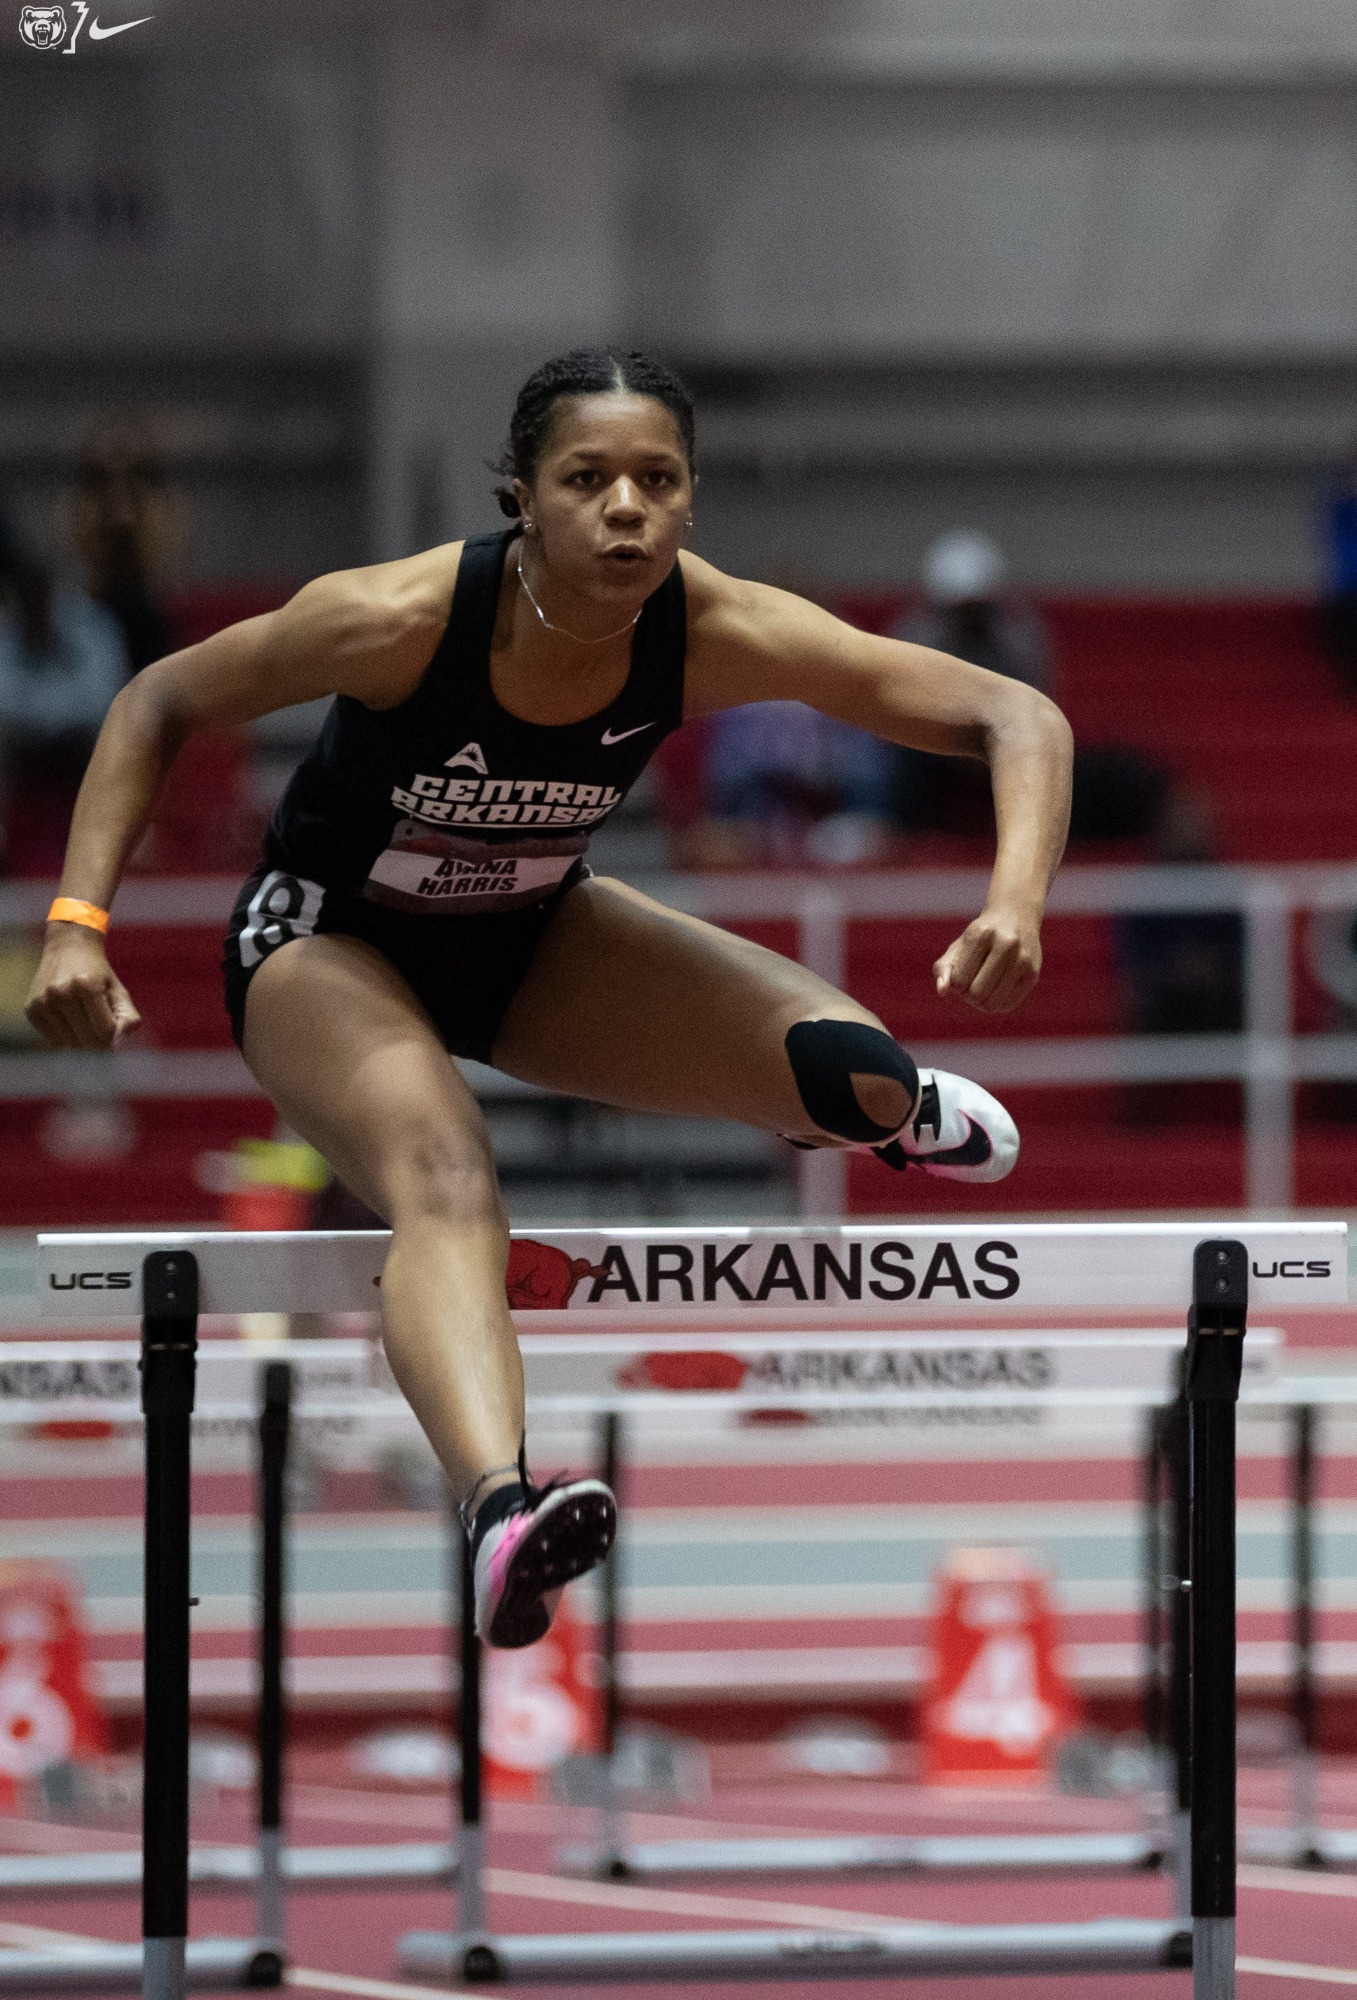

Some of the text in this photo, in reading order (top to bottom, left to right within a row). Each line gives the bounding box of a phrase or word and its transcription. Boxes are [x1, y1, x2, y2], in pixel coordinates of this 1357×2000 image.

[390, 786, 613, 824] ARKANSA
[410, 774, 622, 806] CENTRAL
[416, 876, 518, 896] HARRIS
[50, 1272, 133, 1290] UCS
[587, 1240, 1021, 1303] ARKANSAS
[1252, 1261, 1332, 1278] UCS
[752, 1347, 1052, 1391] ARKANSAS
[932, 1634, 1054, 1755] 4
